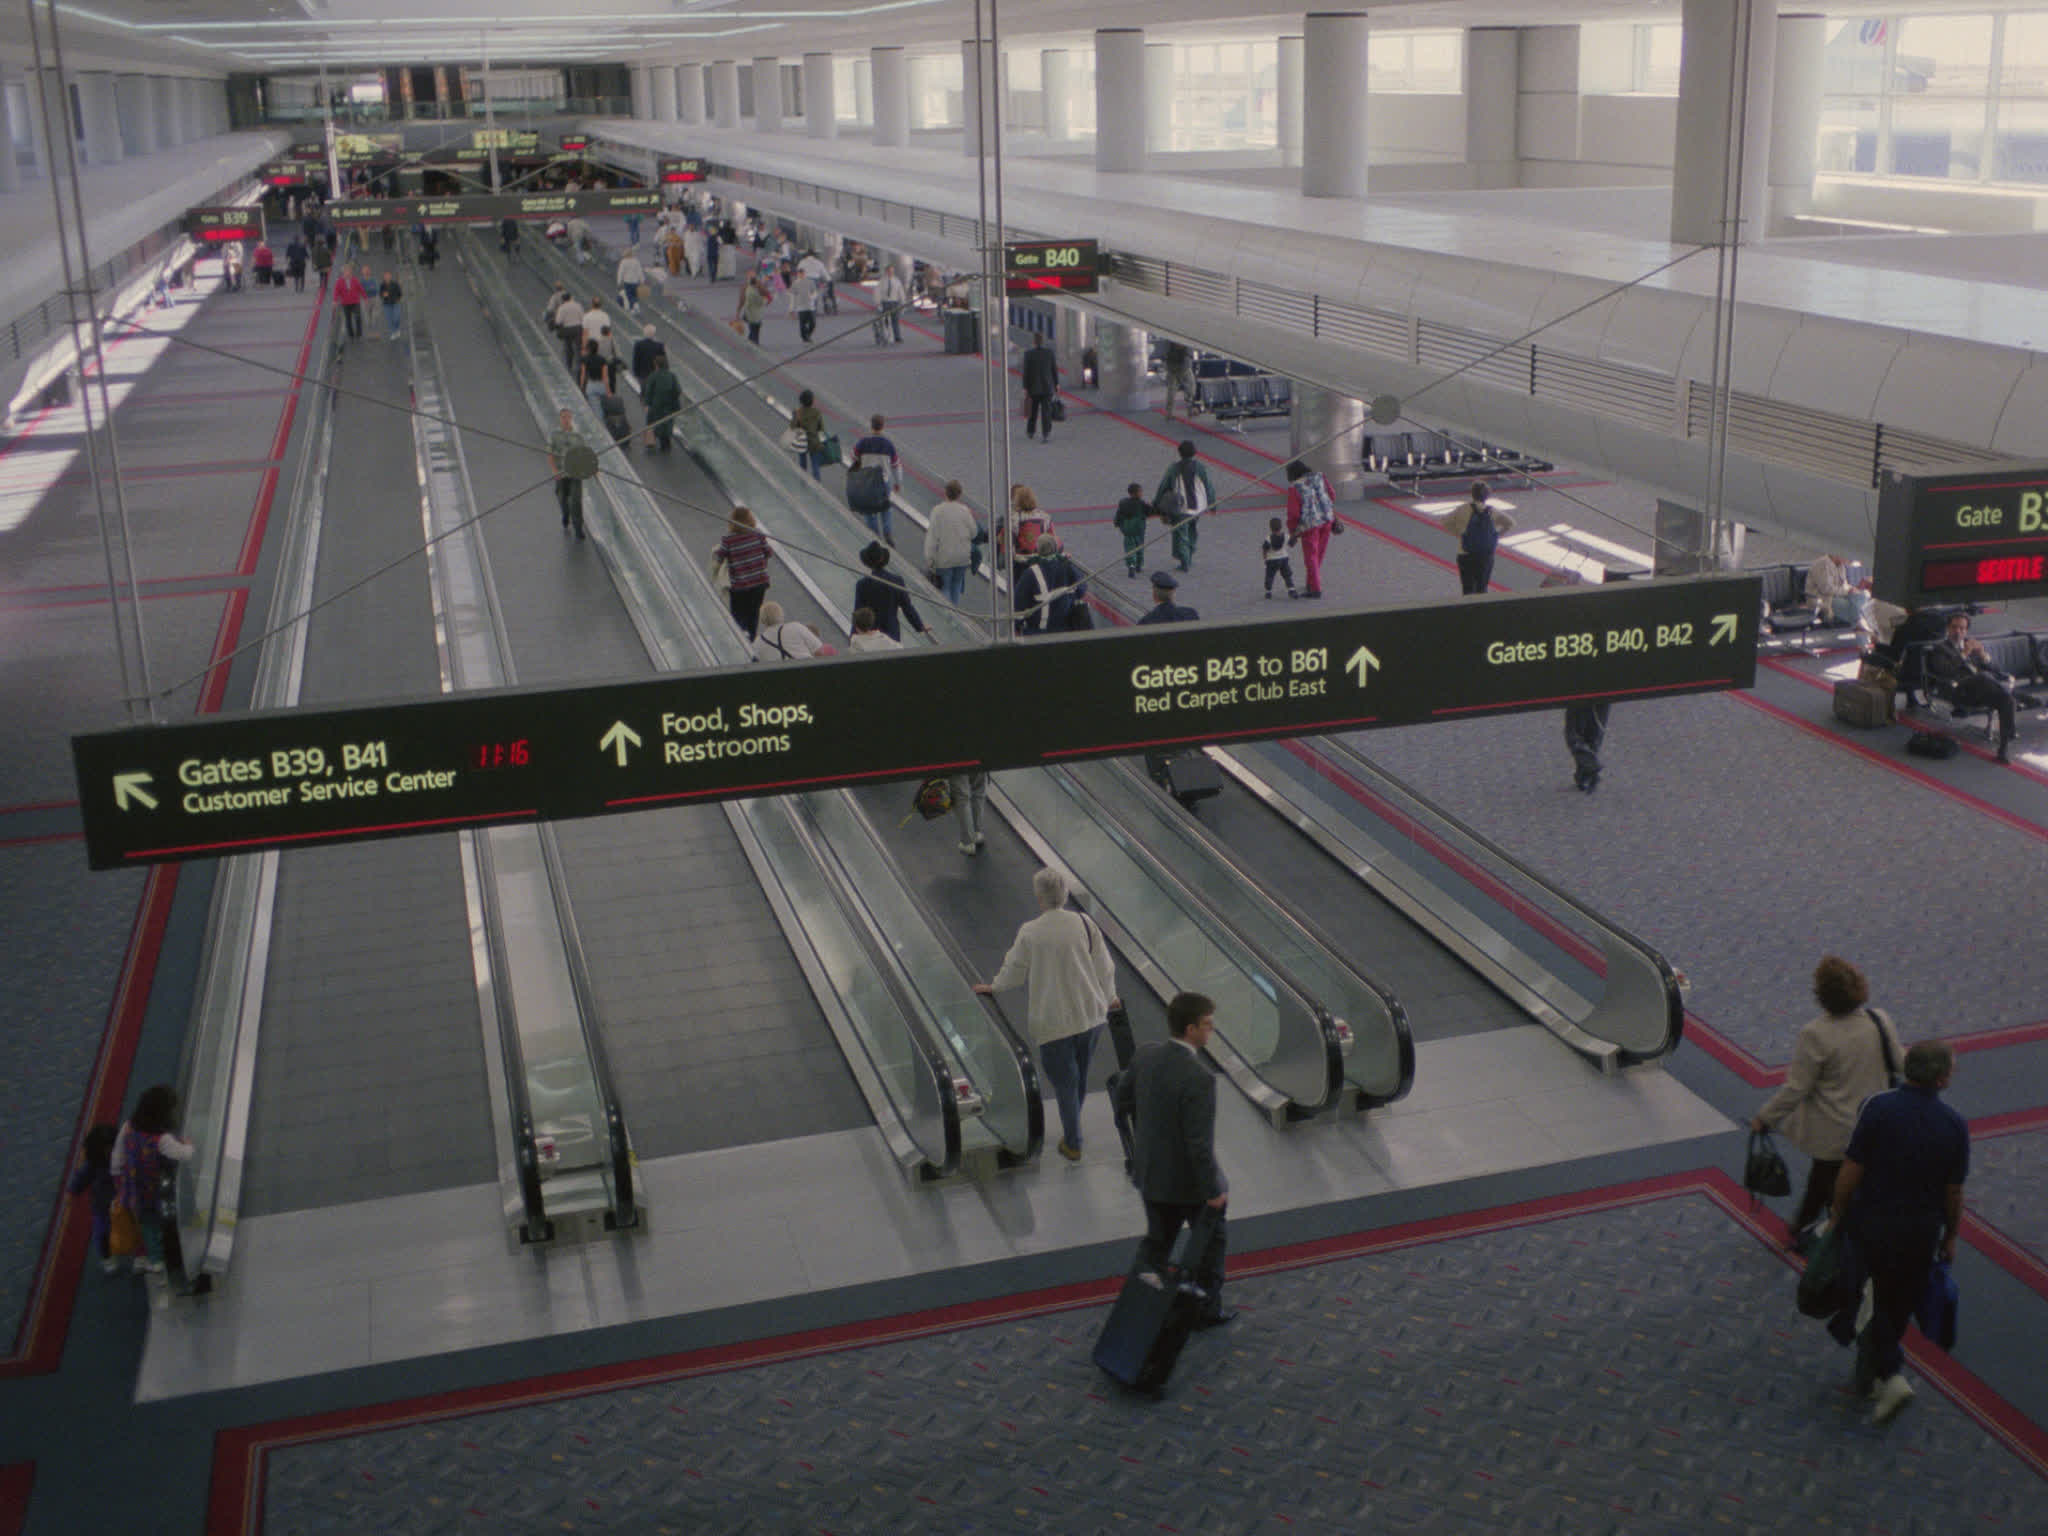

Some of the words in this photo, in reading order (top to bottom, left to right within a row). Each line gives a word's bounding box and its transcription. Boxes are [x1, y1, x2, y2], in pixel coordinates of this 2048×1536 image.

[223, 211, 249, 225] B39
[1015, 253, 1039, 265] Gate
[1045, 247, 1080, 268] B40
[1956, 505, 2003, 528] Gate
[1486, 641, 1548, 665] Gates
[1554, 633, 1599, 658] B38,
[1605, 628, 1649, 653] B40,
[1656, 622, 1694, 648] B42
[1131, 664, 1199, 690] Gates
[1206, 656, 1249, 683] B43
[1257, 655, 1283, 677] to
[1291, 647, 1328, 673] B61
[1135, 691, 1171, 714] Red
[1177, 686, 1239, 711] Carpet
[1244, 681, 1284, 703] Club
[1289, 677, 1328, 698] East
[661, 706, 729, 736] Food,
[738, 703, 814, 729] Shops,
[178, 757, 262, 788] Gates
[271, 747, 335, 778] B39,
[342, 740, 389, 772] B41
[664, 733, 791, 765] Restrooms
[182, 787, 291, 815] Customer
[299, 779, 379, 803] Service
[385, 768, 458, 793] Center
